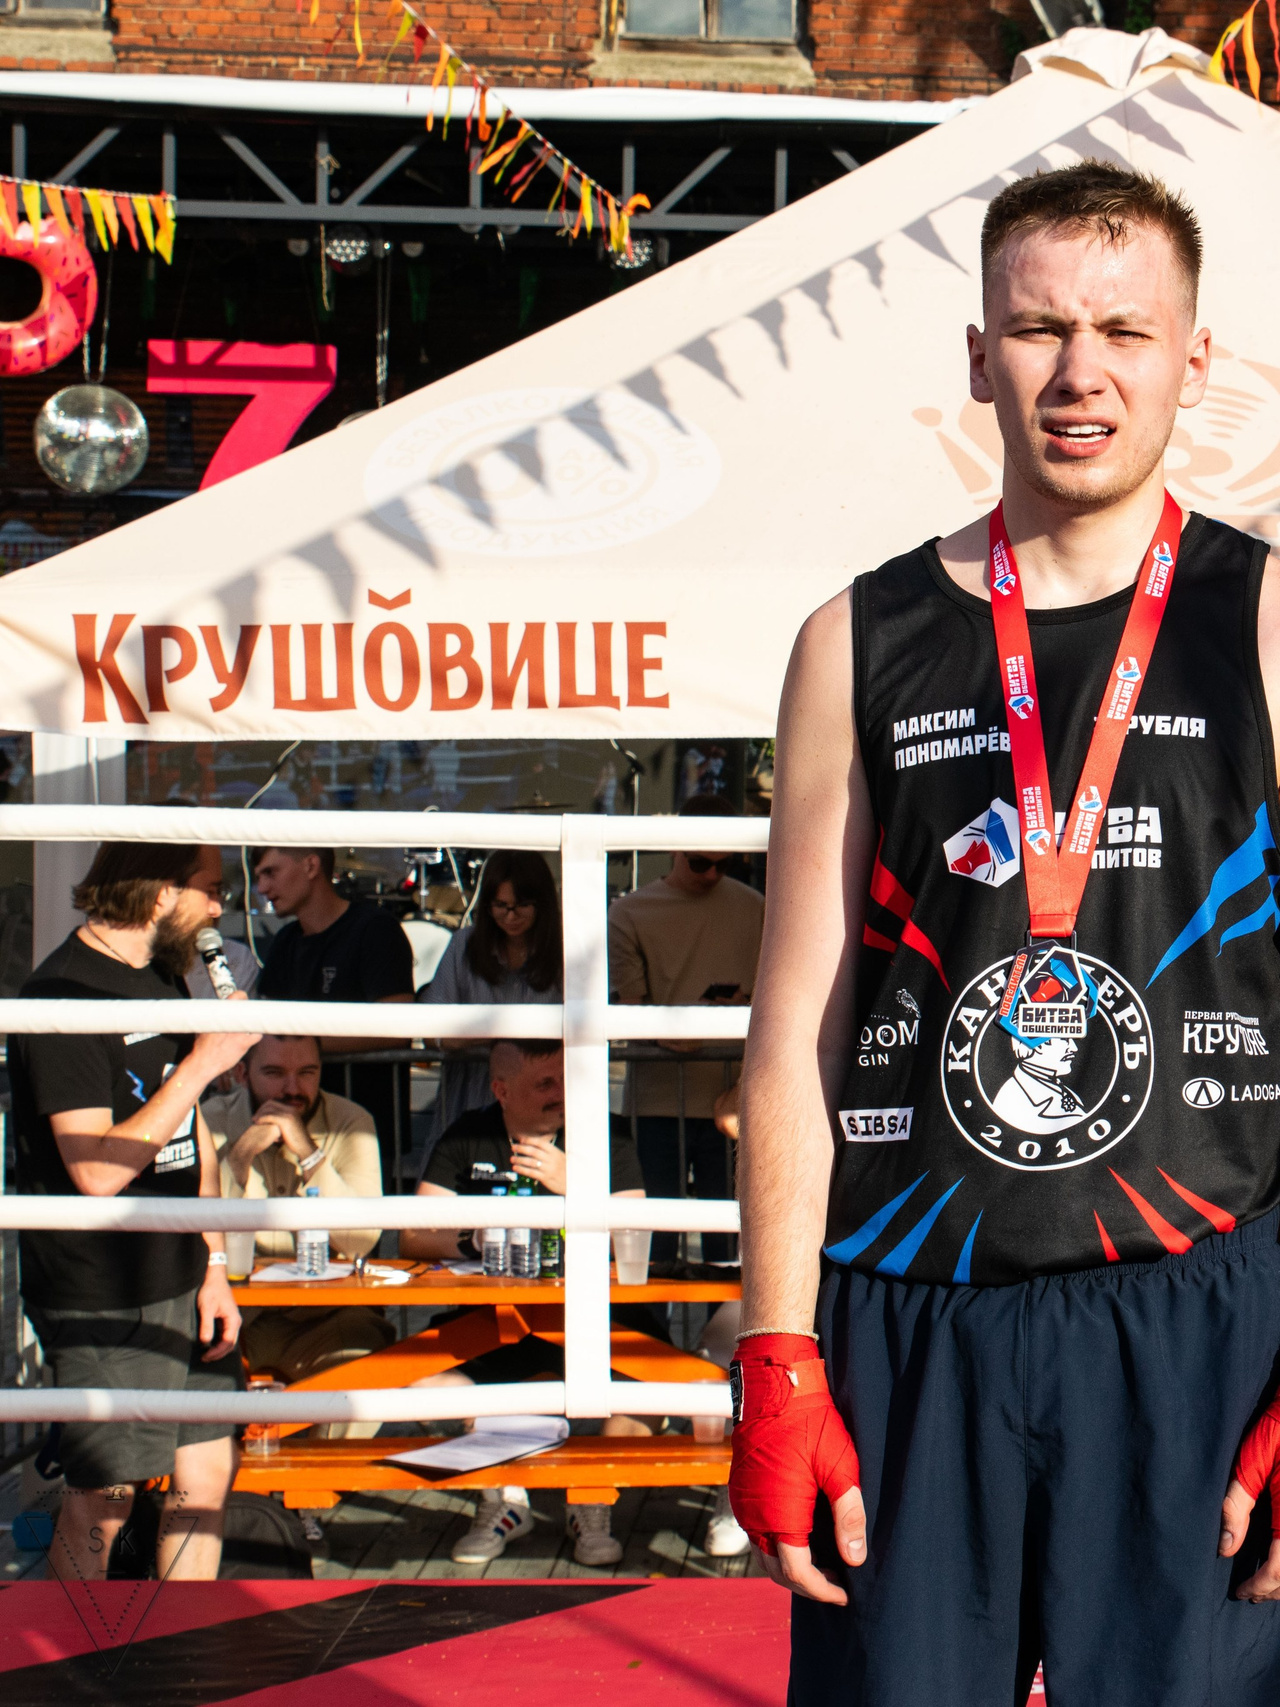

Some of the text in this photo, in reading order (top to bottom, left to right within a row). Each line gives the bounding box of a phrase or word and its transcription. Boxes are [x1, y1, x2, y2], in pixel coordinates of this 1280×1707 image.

[1151, 563, 1170, 598] БИТВА
[1005, 655, 1022, 695] БИТВА
[1113, 681, 1136, 721] БИТВА
[893, 708, 976, 743] МАКСИМ
[895, 726, 1011, 771] ПОНОМАРЁВ
[1022, 786, 1038, 829] БИТВА
[1076, 812, 1097, 855] БИТВА
[1090, 847, 1162, 870] ПИТОВ
[999, 953, 1028, 1018] ПОБЕДИТЕЛЬ
[948, 958, 1148, 1074] КАНЕРЪ
[1021, 1024, 1083, 1034] ОБЩЕПИТОВ
[1022, 1007, 1083, 1024] БИТВА
[1184, 1010, 1223, 1020] ПЕРВАЯ
[858, 1053, 890, 1067] GIN
[847, 1113, 908, 1136] SIBSA
[980, 1118, 1112, 1160] 2010
